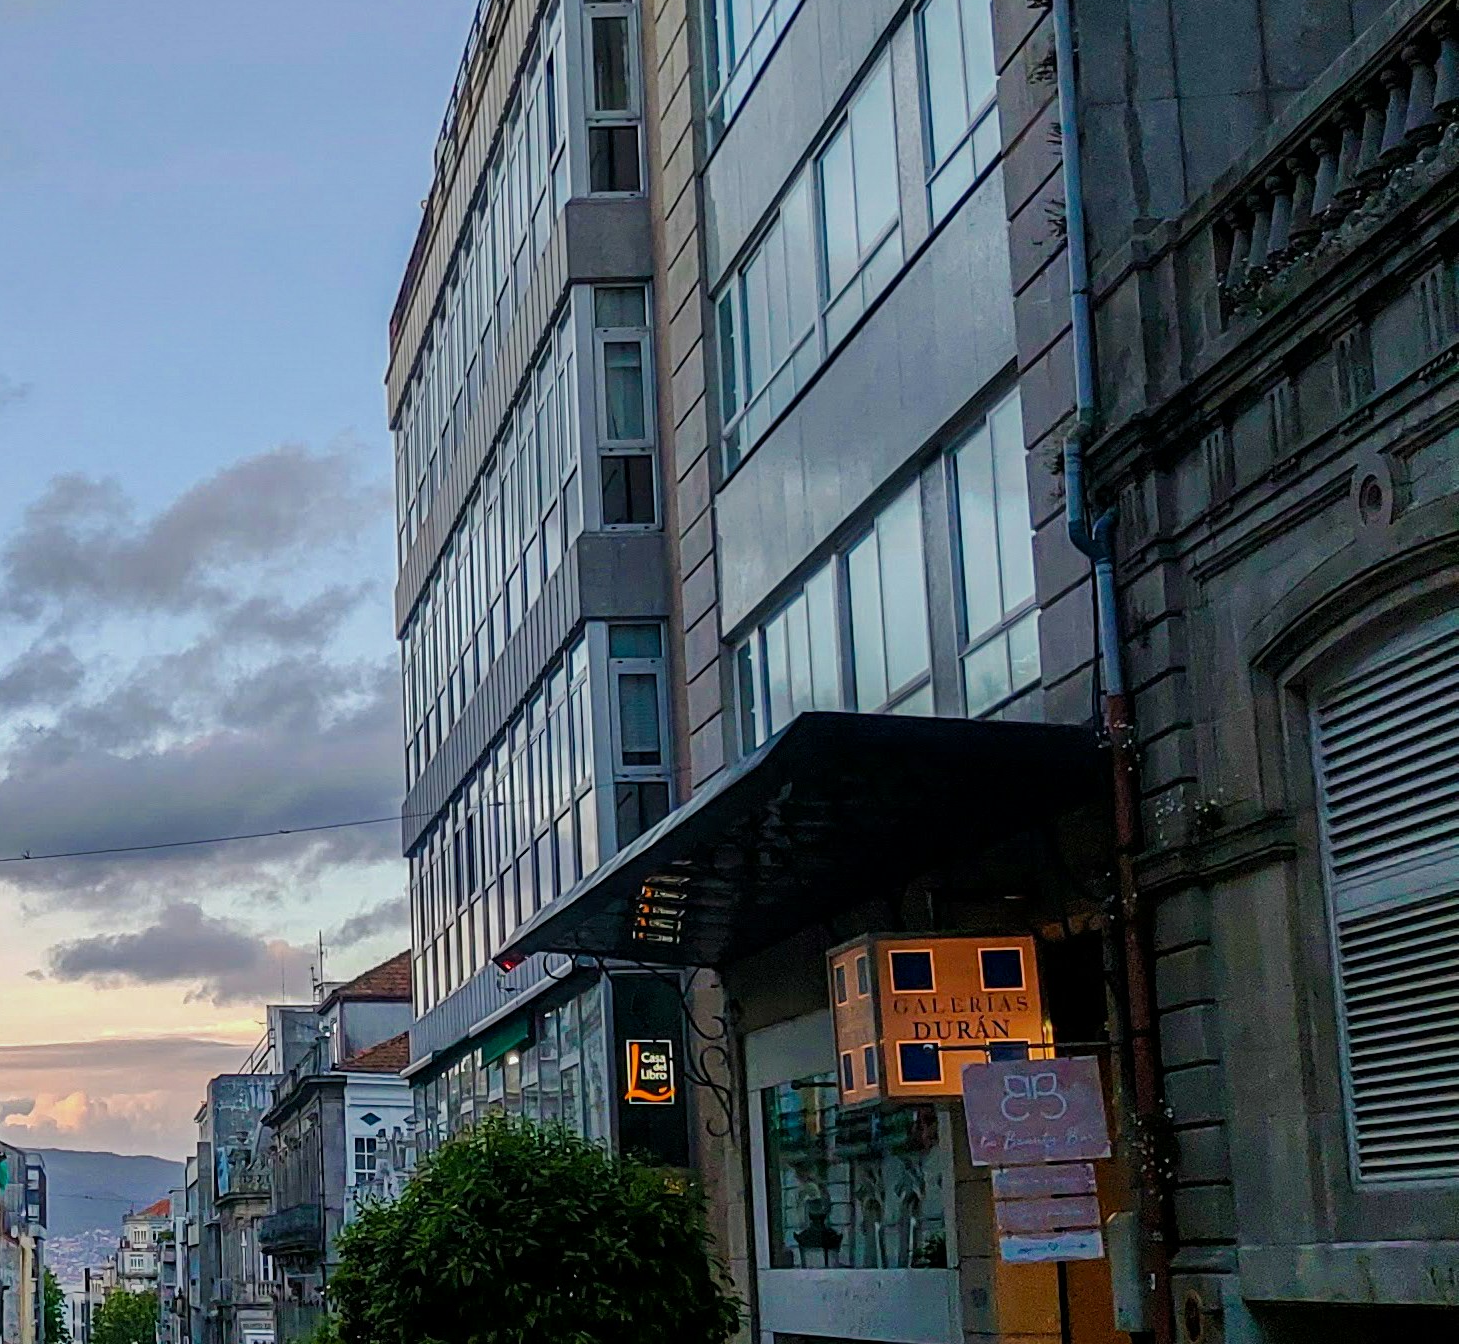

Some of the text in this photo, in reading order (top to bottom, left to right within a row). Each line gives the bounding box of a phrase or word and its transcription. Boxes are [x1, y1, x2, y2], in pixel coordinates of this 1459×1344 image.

[893, 993, 1029, 1014] GALERÍAS
[912, 1015, 1010, 1040] DURÁN
[641, 1051, 666, 1064] Casa
[652, 1062, 667, 1072] del
[640, 1068, 668, 1080] Libro
